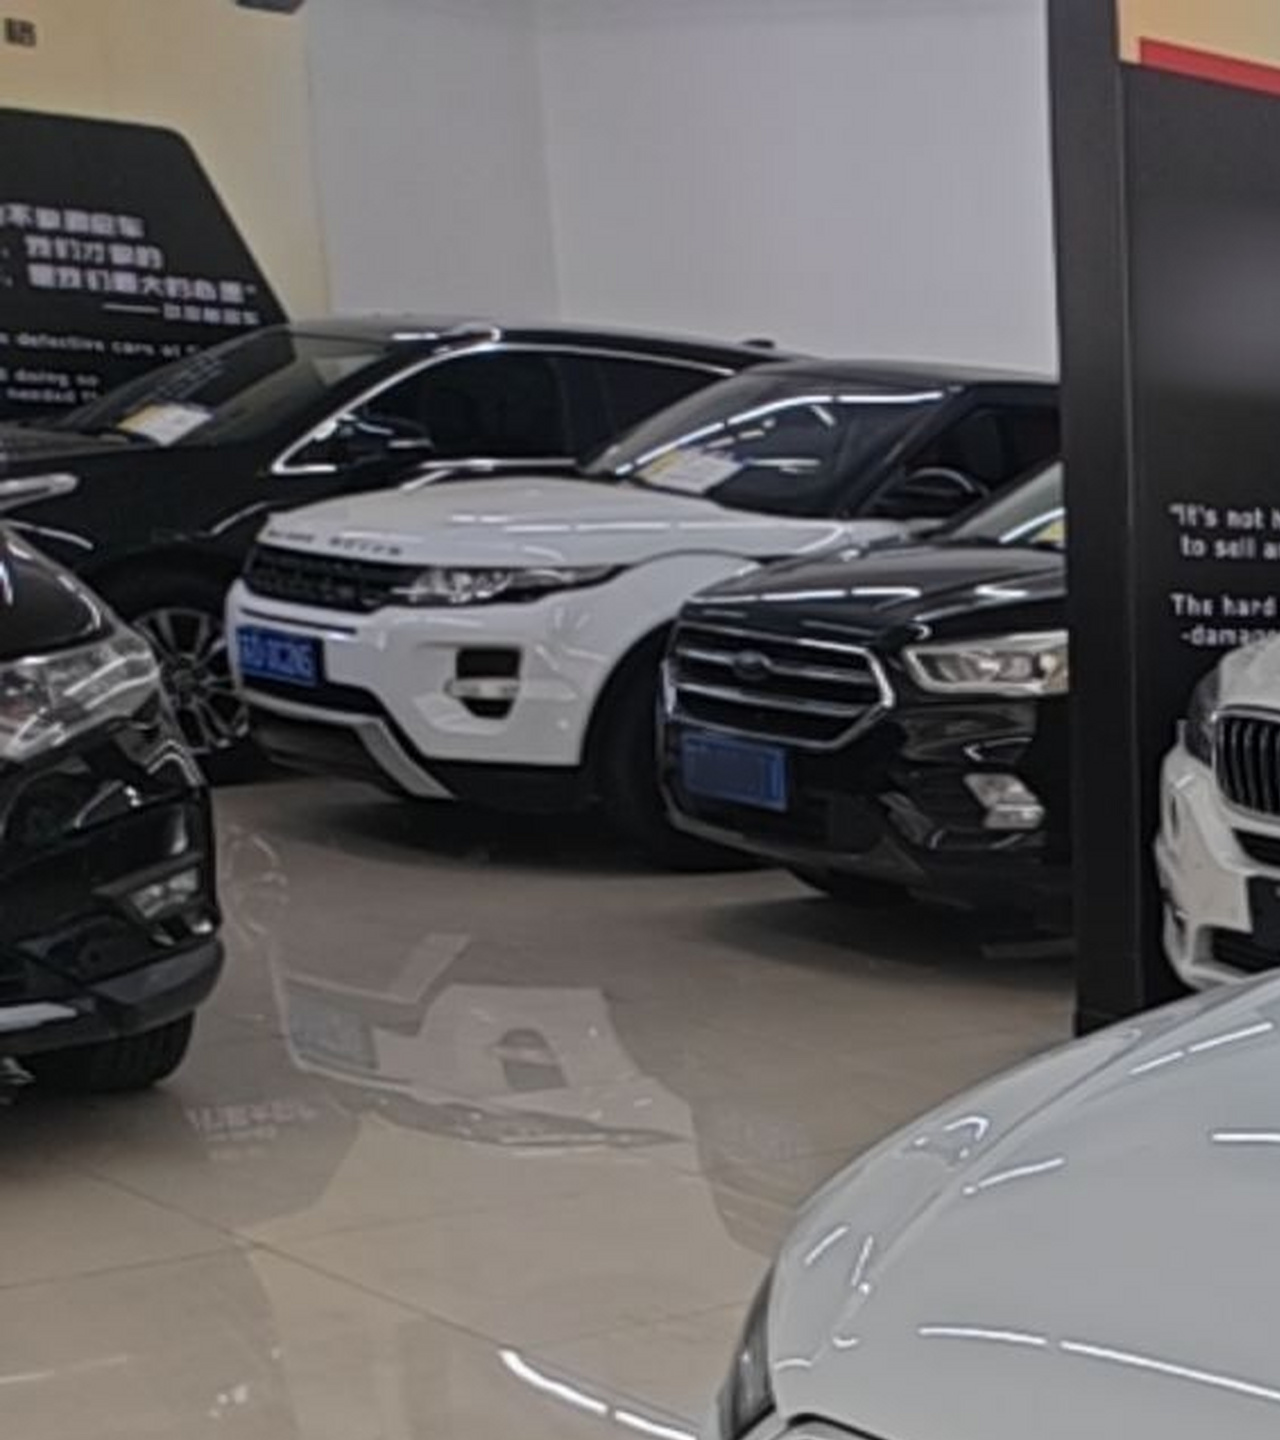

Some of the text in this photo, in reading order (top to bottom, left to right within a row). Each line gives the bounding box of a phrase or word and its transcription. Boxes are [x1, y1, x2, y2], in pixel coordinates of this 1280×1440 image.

[1227, 508, 1264, 529] not
[1180, 533, 1205, 556] to
[1215, 537, 1255, 559] sell
[1170, 592, 1213, 617] The
[1221, 593, 1278, 617] hard
